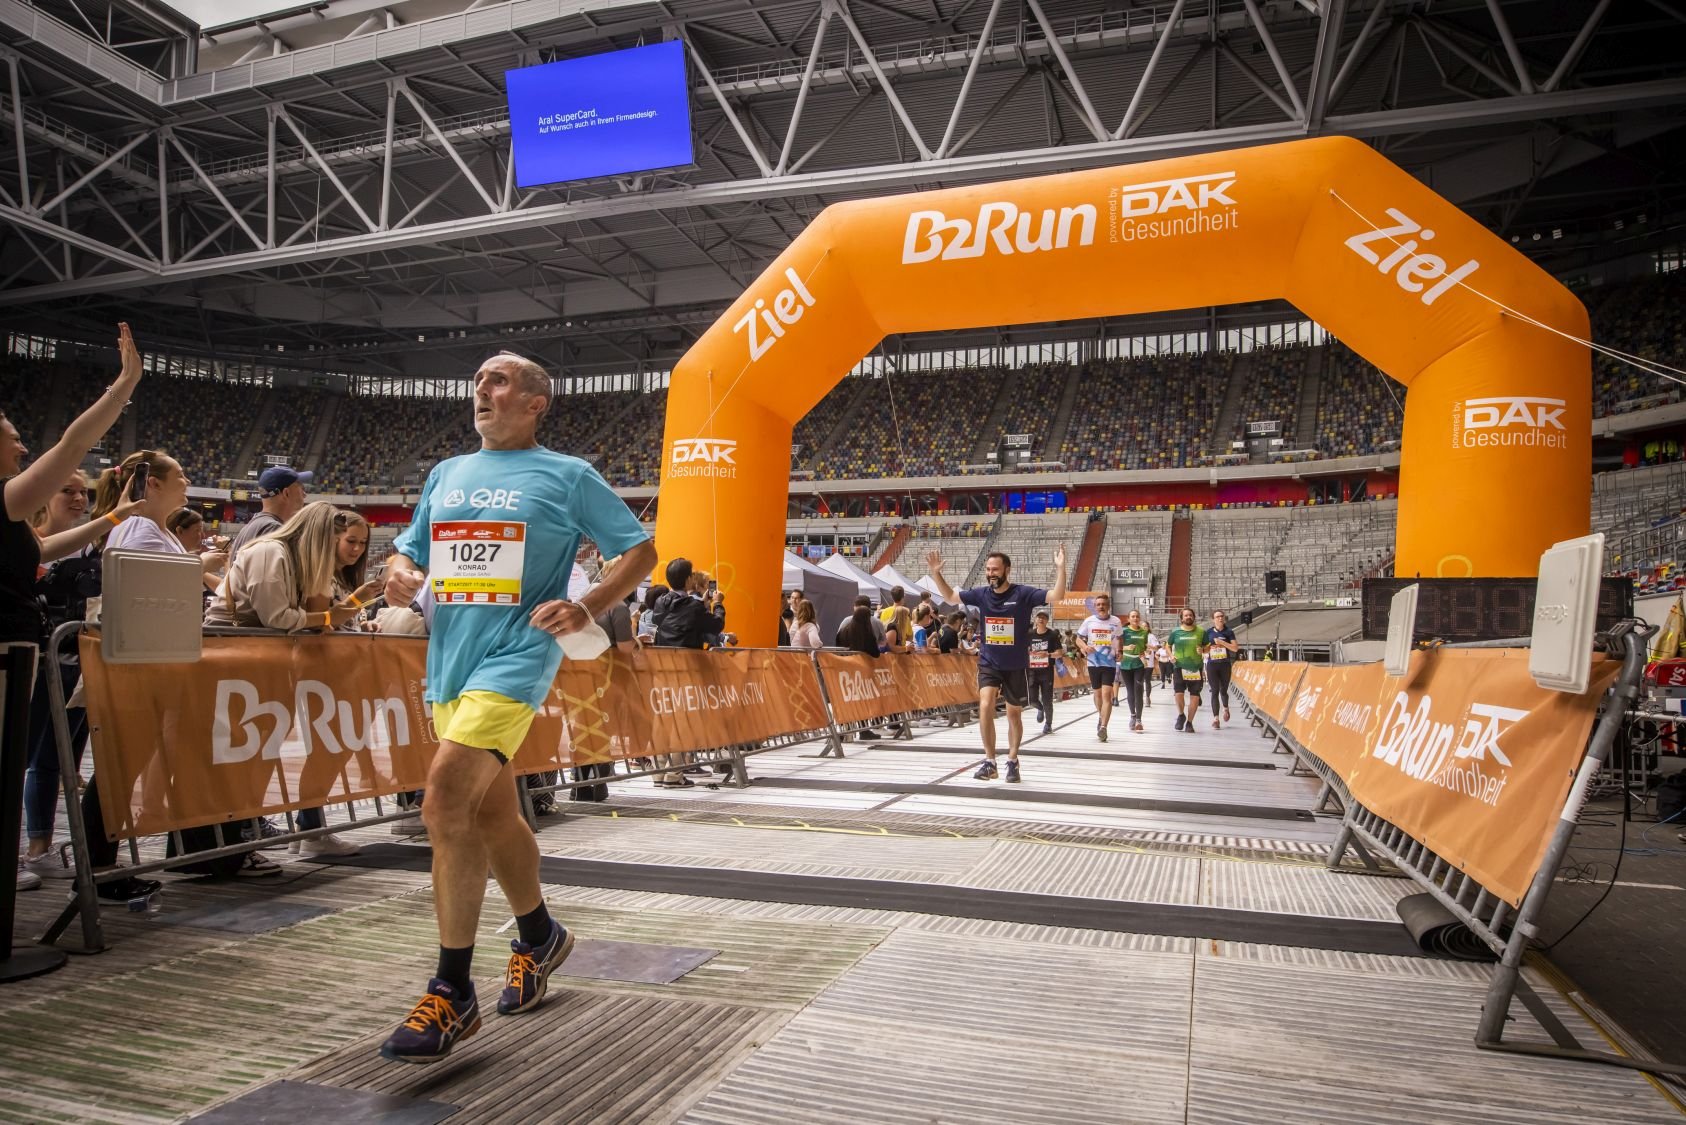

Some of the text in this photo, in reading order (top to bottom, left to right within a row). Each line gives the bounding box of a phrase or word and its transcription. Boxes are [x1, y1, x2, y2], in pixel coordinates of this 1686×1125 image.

[538, 108, 598, 126] Aral SuperCard.
[540, 126, 549, 134] Auf
[550, 123, 573, 132] Wunsch
[575, 120, 589, 128] auch
[597, 116, 614, 125] Ihrem
[1122, 171, 1238, 218] DAK
[1109, 187, 1119, 243] powered by
[1121, 207, 1239, 242] Gesundheit
[902, 202, 1097, 265] B2Run
[1344, 208, 1480, 306] Ziel
[733, 267, 816, 363] Ziel
[1453, 401, 1462, 449] powered by
[1464, 396, 1567, 431] DAK
[672, 438, 737, 465] DAK
[1463, 428, 1567, 449] Gesundheit
[671, 461, 737, 479] Gesundheit
[470, 488, 522, 511] QBE
[450, 543, 502, 562] 1027
[1134, 570, 1142, 578] 41
[991, 624, 1005, 632] 914
[650, 684, 740, 715] GEMEINSAM
[839, 670, 881, 702] B2Run
[212, 679, 410, 765] B2Run
[1372, 691, 1454, 782] B2Run
